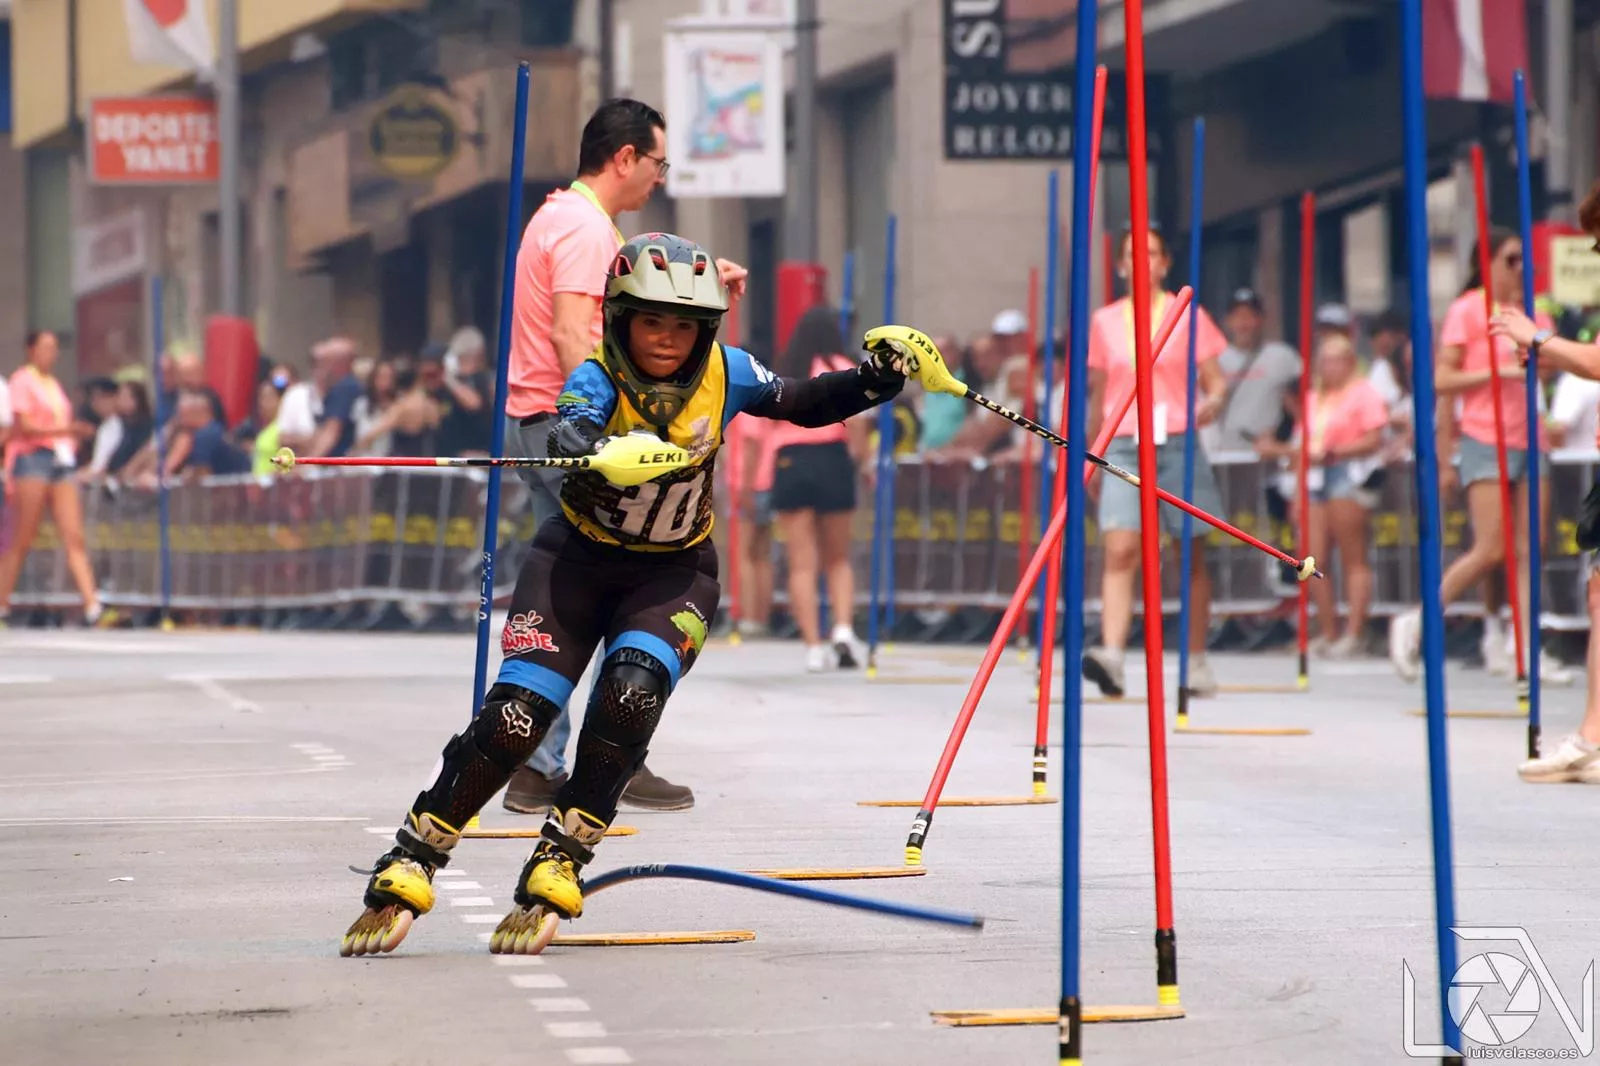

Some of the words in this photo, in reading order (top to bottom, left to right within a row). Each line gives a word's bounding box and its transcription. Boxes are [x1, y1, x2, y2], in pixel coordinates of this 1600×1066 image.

[953, 82, 1114, 113] JOYER
[96, 112, 218, 143] DEPORTE
[124, 144, 207, 173] YANET
[907, 332, 940, 363] LEKI
[973, 393, 1021, 421] LEKI
[638, 452, 683, 465] LEKI
[593, 470, 707, 543] 30
